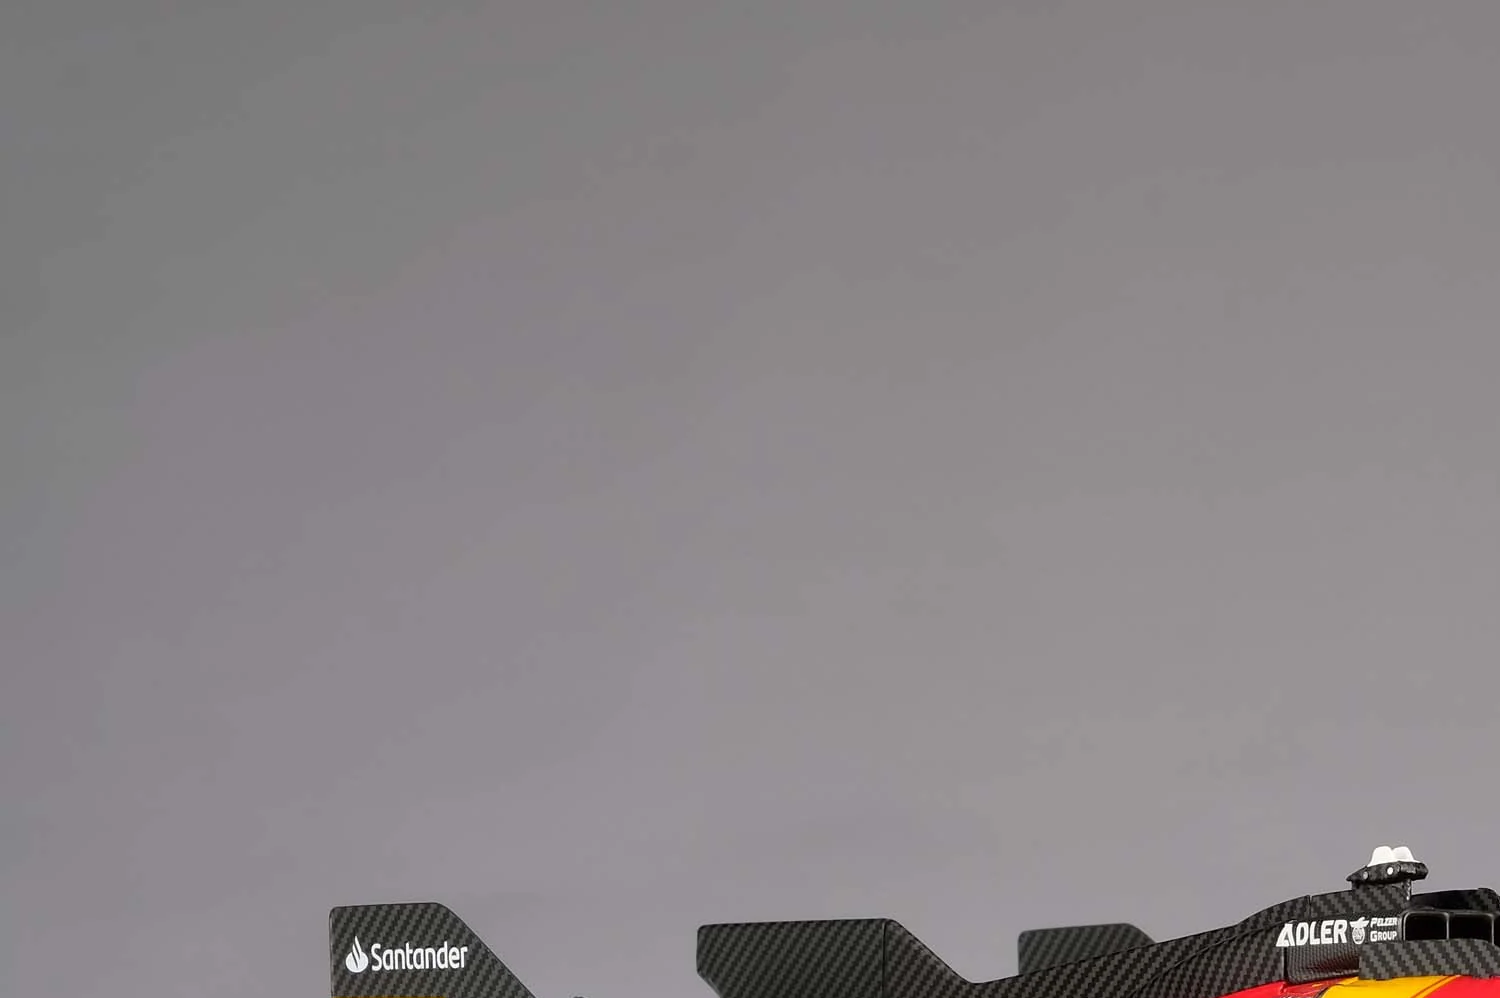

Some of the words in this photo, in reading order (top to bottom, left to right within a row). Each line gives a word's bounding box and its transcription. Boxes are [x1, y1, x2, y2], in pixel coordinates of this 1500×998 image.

[1276, 919, 1348, 948] ADLER
[1369, 930, 1398, 942] GROUP
[371, 941, 468, 972] Santander
